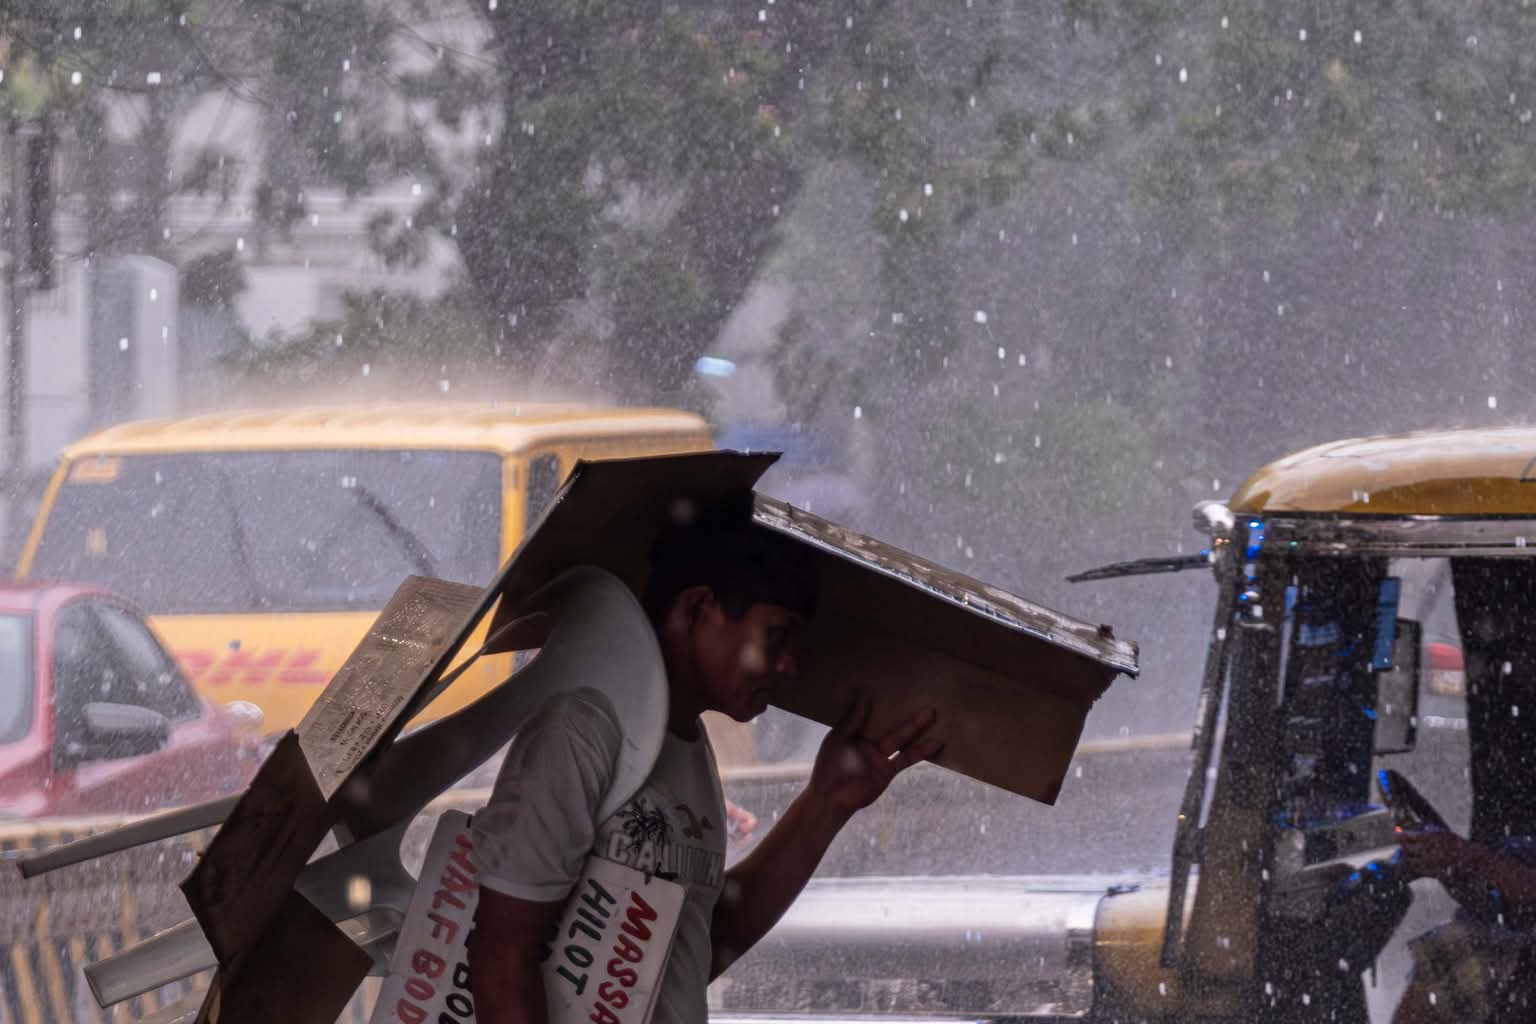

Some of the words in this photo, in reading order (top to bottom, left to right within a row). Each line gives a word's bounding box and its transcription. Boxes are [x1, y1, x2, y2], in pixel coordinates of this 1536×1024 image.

[174, 648, 332, 684] DHL
[427, 834, 476, 945] HALF
[556, 878, 617, 996] HILOT
